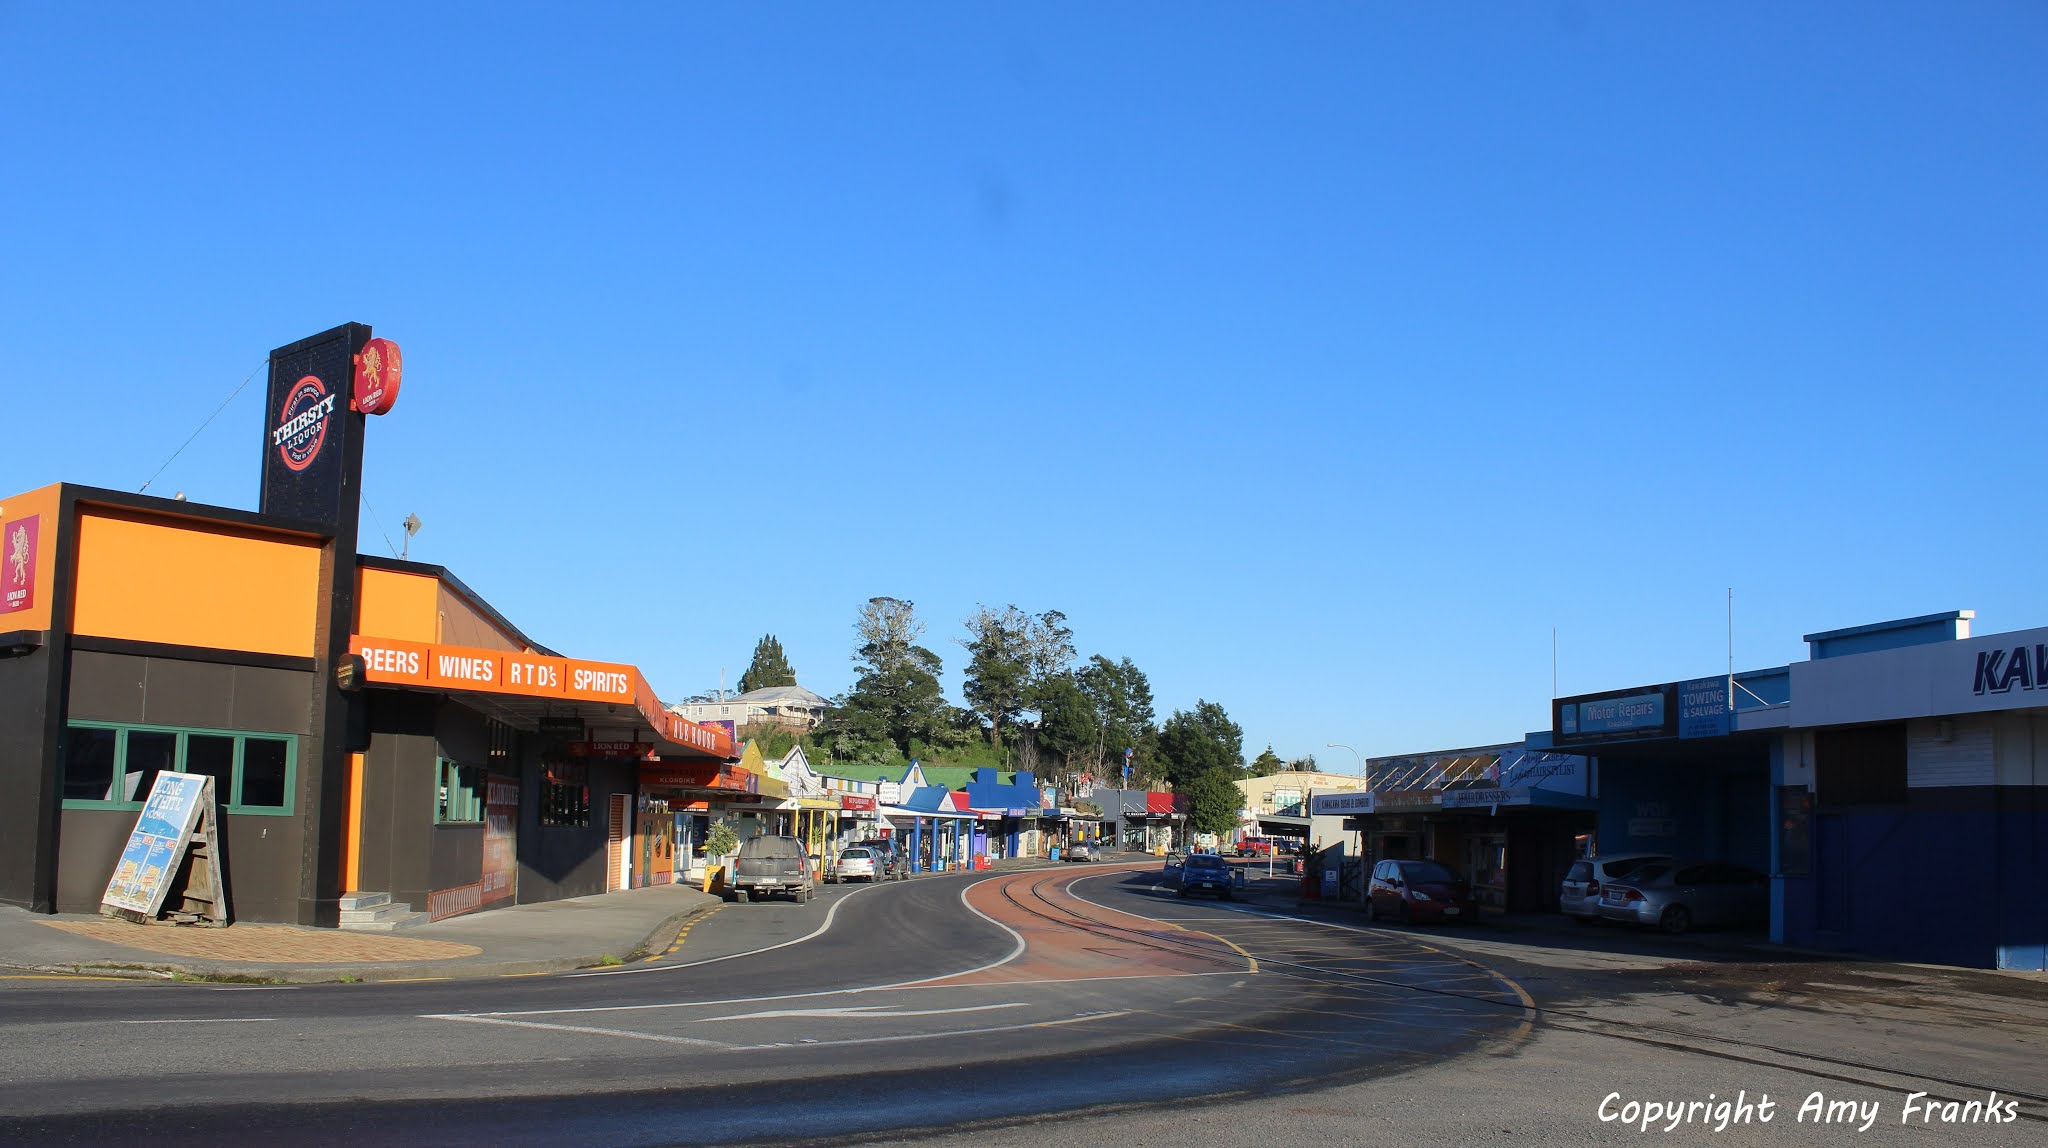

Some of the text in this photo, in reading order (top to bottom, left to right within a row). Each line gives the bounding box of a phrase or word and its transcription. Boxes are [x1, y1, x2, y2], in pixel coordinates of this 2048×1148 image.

[273, 394, 335, 446] THIRSTY
[287, 421, 322, 450] LIQUOR
[361, 648, 419, 674] BEERS
[438, 655, 493, 682] WINES
[573, 669, 628, 695] SPIRITS
[1683, 690, 1725, 706] TOWING
[1587, 701, 1653, 721] Motor Repairs
[1683, 704, 1725, 718] & SALVAGE
[673, 719, 689, 743] ALE
[691, 726, 717, 751] HOUSE
[593, 743, 630, 751] LION RED
[156, 780, 185, 796] LONG
[151, 793, 184, 811] WHITE
[1458, 791, 1511, 804] HAIRDRESSERS
